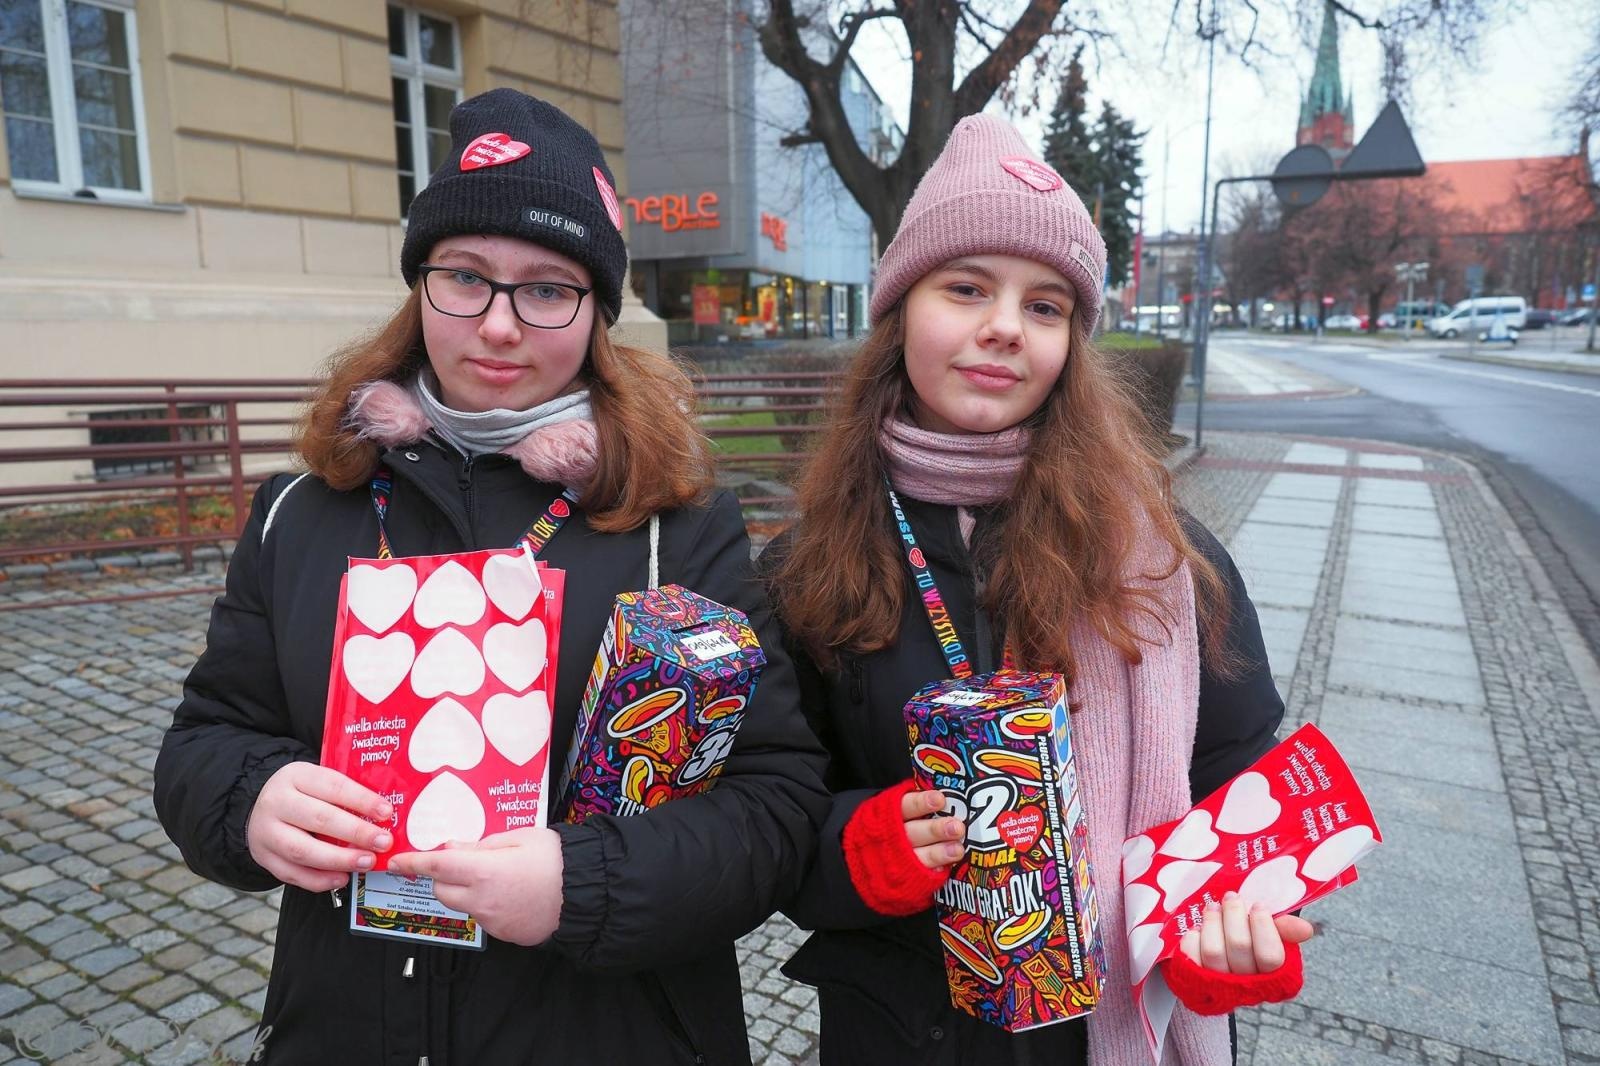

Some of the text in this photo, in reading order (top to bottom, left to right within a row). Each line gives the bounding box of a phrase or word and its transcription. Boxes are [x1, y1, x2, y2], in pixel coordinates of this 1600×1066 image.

[529, 210, 585, 237] OUT OF MIND
[916, 570, 934, 588] TU
[923, 587, 962, 654] WSZYSTKO
[345, 715, 406, 734] wielka orkiestra
[351, 731, 400, 751] świątecznej
[1038, 735, 1050, 766] PŁUCA
[360, 750, 392, 766] pomocy
[1293, 740, 1316, 763] wielka
[936, 775, 966, 790] 2024
[1043, 766, 1053, 781] PO
[488, 779, 542, 796] wielka orkies
[506, 814, 536, 830] pomoc
[970, 848, 1017, 867] FINAŁ
[1053, 831, 1066, 866] GRAMY
[1058, 866, 1069, 885] DLA
[976, 886, 1010, 920] GRA!
[1009, 870, 1045, 917] OK!
[1061, 885, 1074, 916] DZIECI
